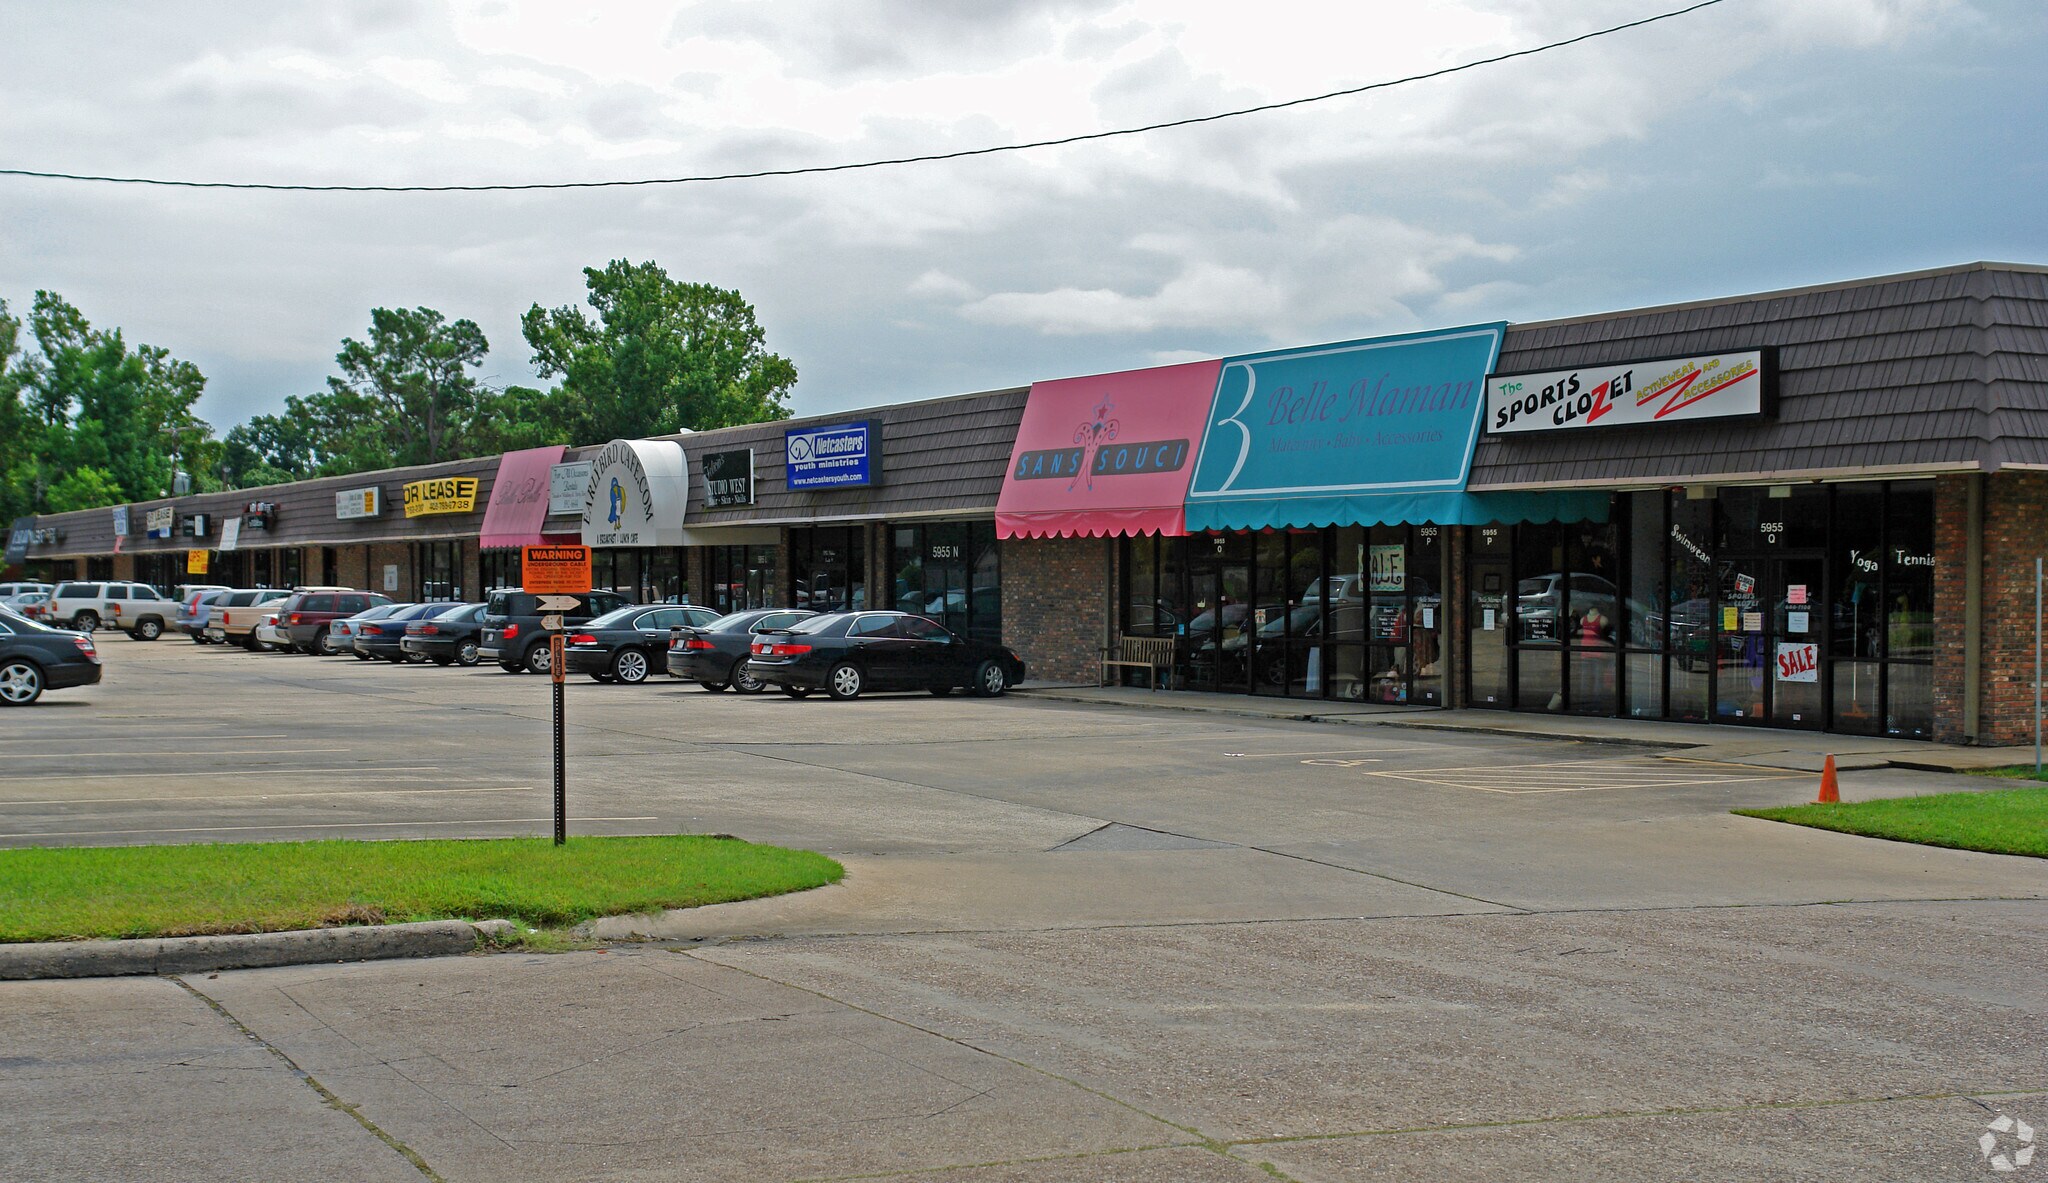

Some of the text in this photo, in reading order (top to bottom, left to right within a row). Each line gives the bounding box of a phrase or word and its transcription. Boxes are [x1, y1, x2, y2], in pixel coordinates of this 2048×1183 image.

[1636, 358, 1720, 401] ACTIVEWEAR AND
[1683, 359, 1754, 401] ACCESSORIES
[1266, 371, 1475, 426] Belle Maman
[1498, 382, 1523, 397] The
[1553, 369, 1633, 426] CLOZET
[1496, 372, 1580, 429] SPORTS
[816, 435, 864, 455] Netcasters
[1267, 427, 1443, 453] Maternity Baby Accessories
[795, 458, 859, 472] youth ministries
[1018, 444, 1183, 476] SANS SOUCI
[708, 477, 746, 496] STUDIO WEST
[793, 473, 863, 486] www.netcastersyouth.com
[422, 481, 475, 501] LEASE
[1420, 527, 1438, 536] 5955
[1760, 522, 1784, 533] 5955
[1426, 537, 1432, 546] P
[1487, 537, 1493, 546] P
[1767, 533, 1776, 544] Q
[531, 550, 583, 560] WARNING
[932, 545, 959, 558] 5955 N
[1850, 549, 1879, 572] Yoga
[1895, 548, 1935, 566] Tennis
[1361, 553, 1402, 585] ALE
[1778, 645, 1816, 678] SALE
